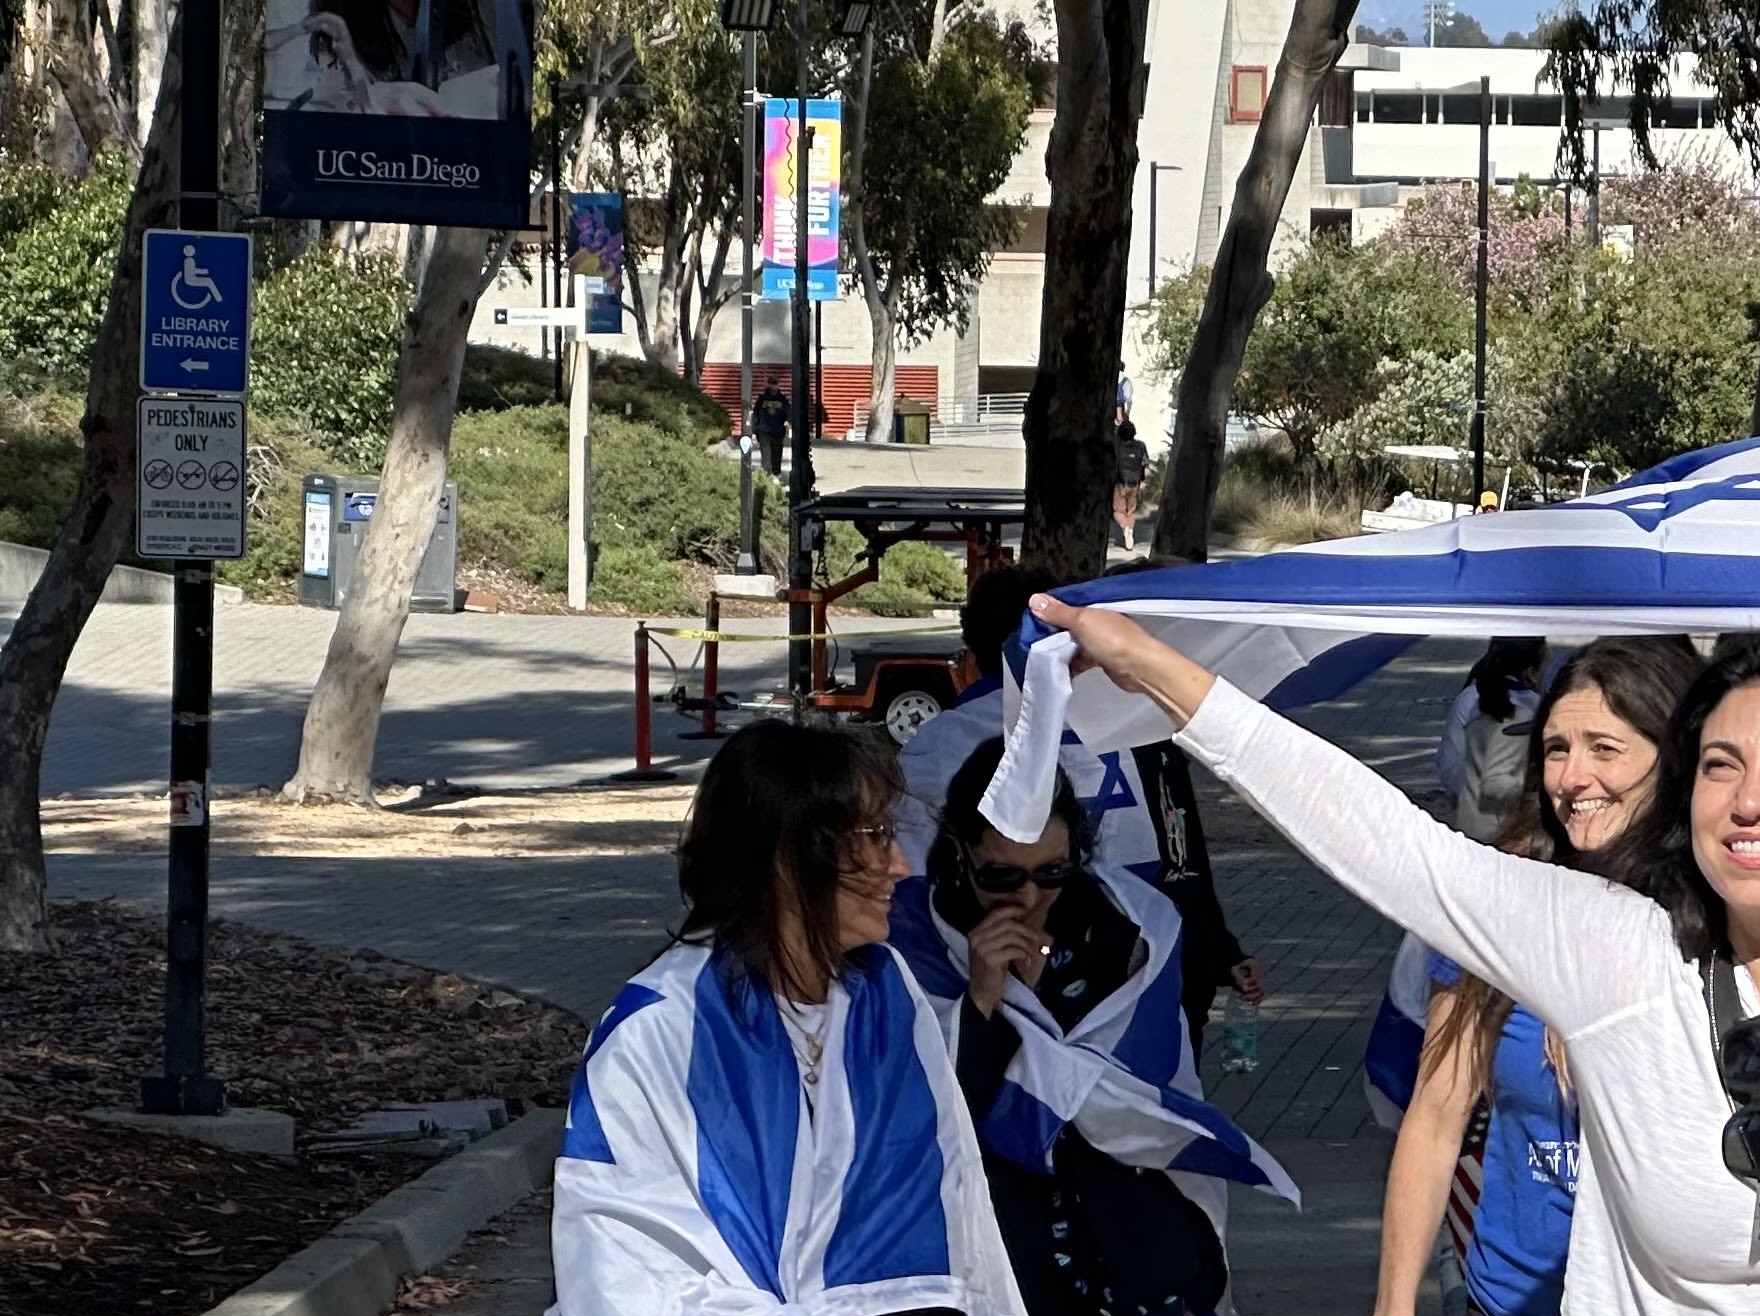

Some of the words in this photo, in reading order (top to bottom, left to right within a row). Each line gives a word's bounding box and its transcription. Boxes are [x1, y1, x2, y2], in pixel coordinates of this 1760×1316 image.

[316, 149, 357, 177] UC
[359, 151, 407, 180] San
[410, 153, 480, 188] Diego
[161, 316, 230, 333] LIBRARY
[151, 332, 240, 351] ENTRANCE
[147, 409, 237, 429] PEDESTRIANS
[175, 434, 209, 452] ONLY
